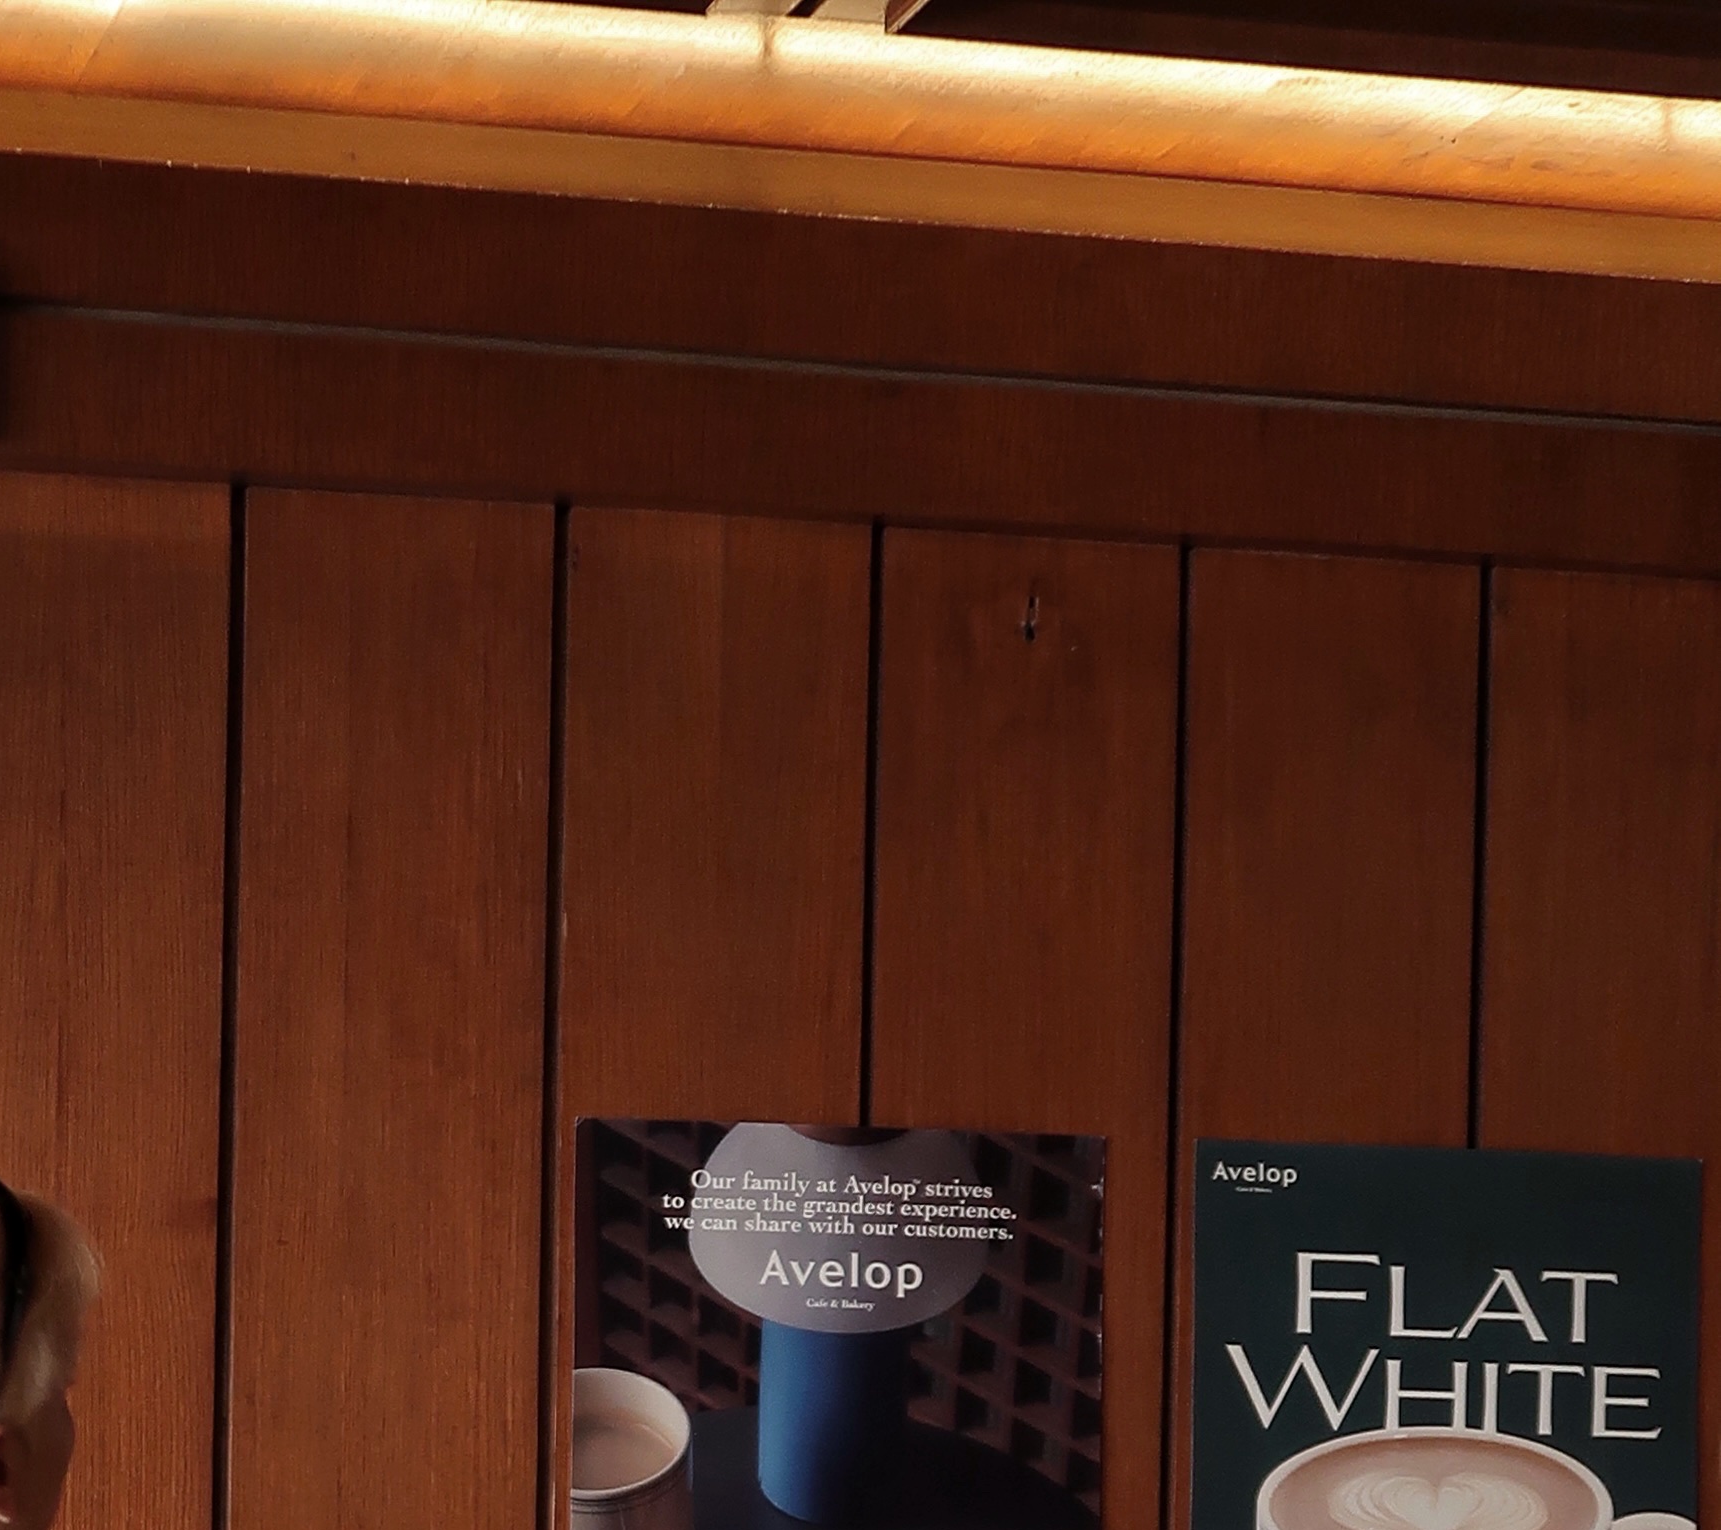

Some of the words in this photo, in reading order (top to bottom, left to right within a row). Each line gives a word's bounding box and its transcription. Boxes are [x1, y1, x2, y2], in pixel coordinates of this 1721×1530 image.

[691, 1169, 735, 1189] Our
[742, 1170, 810, 1197] family
[816, 1179, 837, 1193] at
[925, 1179, 993, 1198] strives
[1212, 1160, 1297, 1187] Avelop
[662, 1194, 685, 1209] to
[691, 1195, 757, 1210] create
[763, 1193, 797, 1212] the
[803, 1195, 895, 1218] grandest
[900, 1200, 1018, 1222] experience.
[664, 1216, 695, 1230] we
[701, 1217, 738, 1231] can
[744, 1213, 802, 1232] share
[808, 1215, 855, 1234] with
[862, 1222, 899, 1236] our
[904, 1223, 1014, 1240] customers.
[759, 1250, 924, 1298] Avelop
[841, 1299, 876, 1311] Bakery
[1295, 1251, 1619, 1344] FLAT
[1225, 1343, 1662, 1439] WHITE
